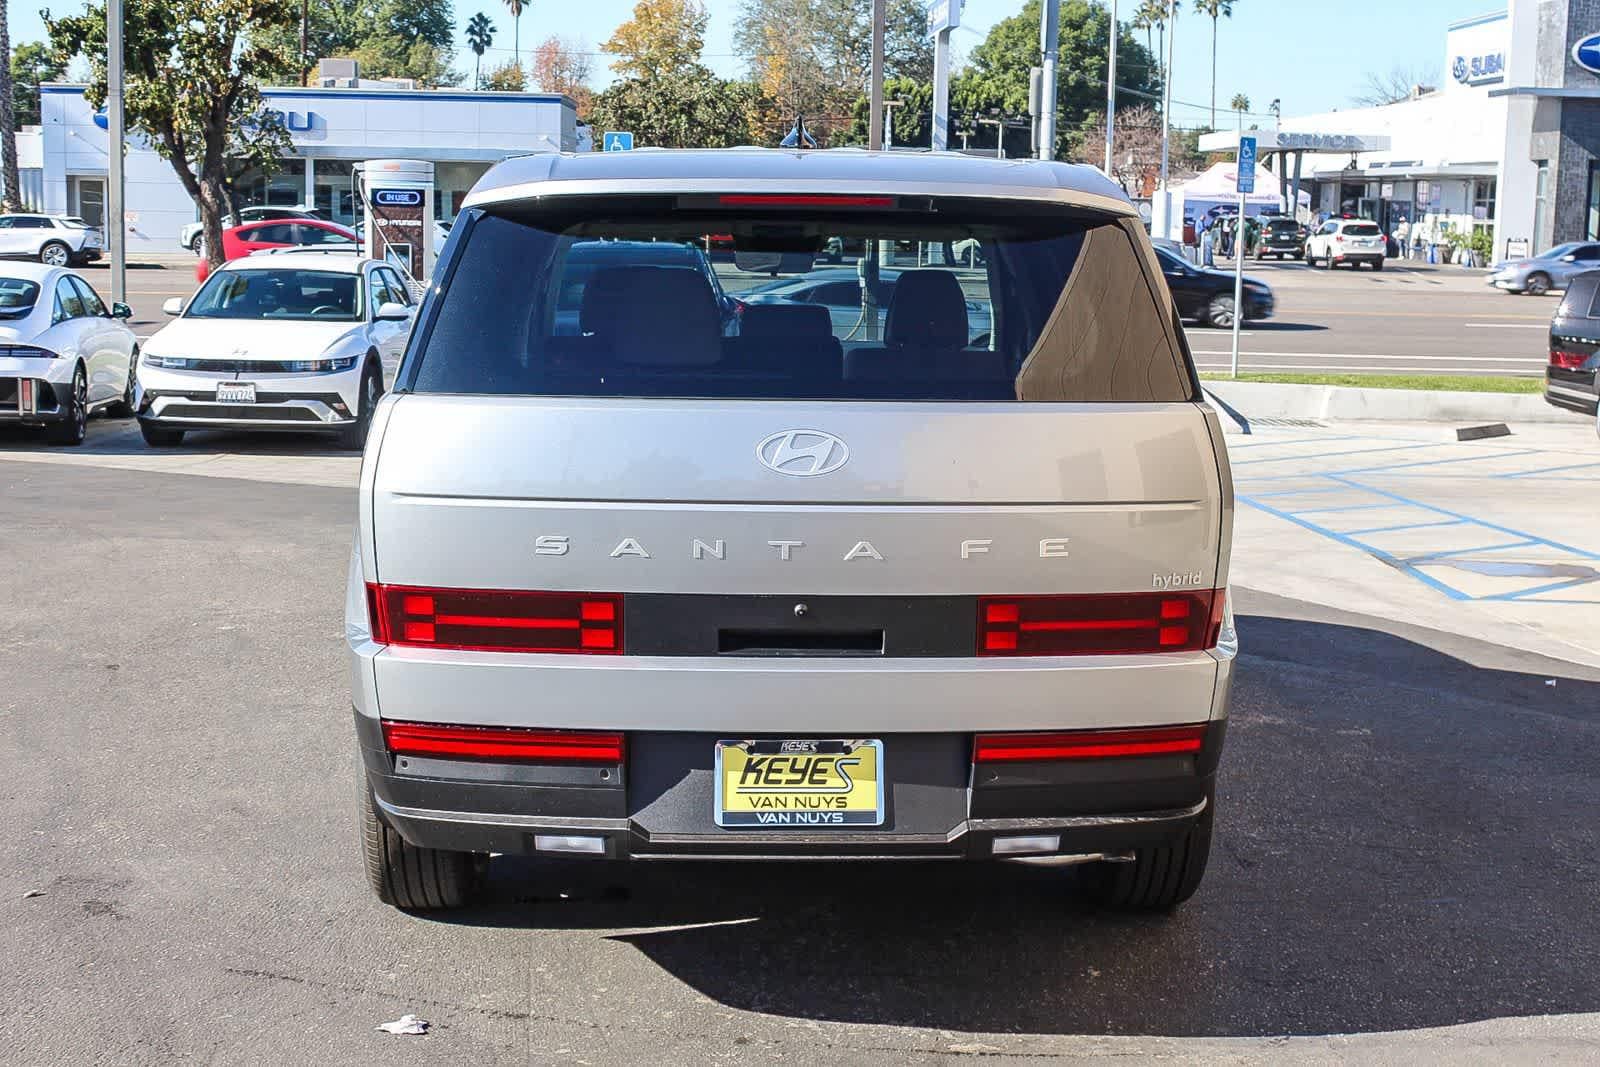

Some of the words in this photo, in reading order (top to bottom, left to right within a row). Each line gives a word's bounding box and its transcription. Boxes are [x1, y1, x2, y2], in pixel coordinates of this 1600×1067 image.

[1277, 133, 1362, 148] SERVICE
[395, 193, 409, 202] USE
[535, 535, 884, 560] SANTA
[961, 537, 1070, 559] FE
[1152, 571, 1202, 590] hybrid
[780, 741, 819, 753] KEYES
[736, 757, 861, 794] KEYES
[749, 796, 787, 809] VAN
[794, 796, 848, 809] NUYS
[756, 812, 790, 824] VAN
[795, 812, 844, 824] NUYS
